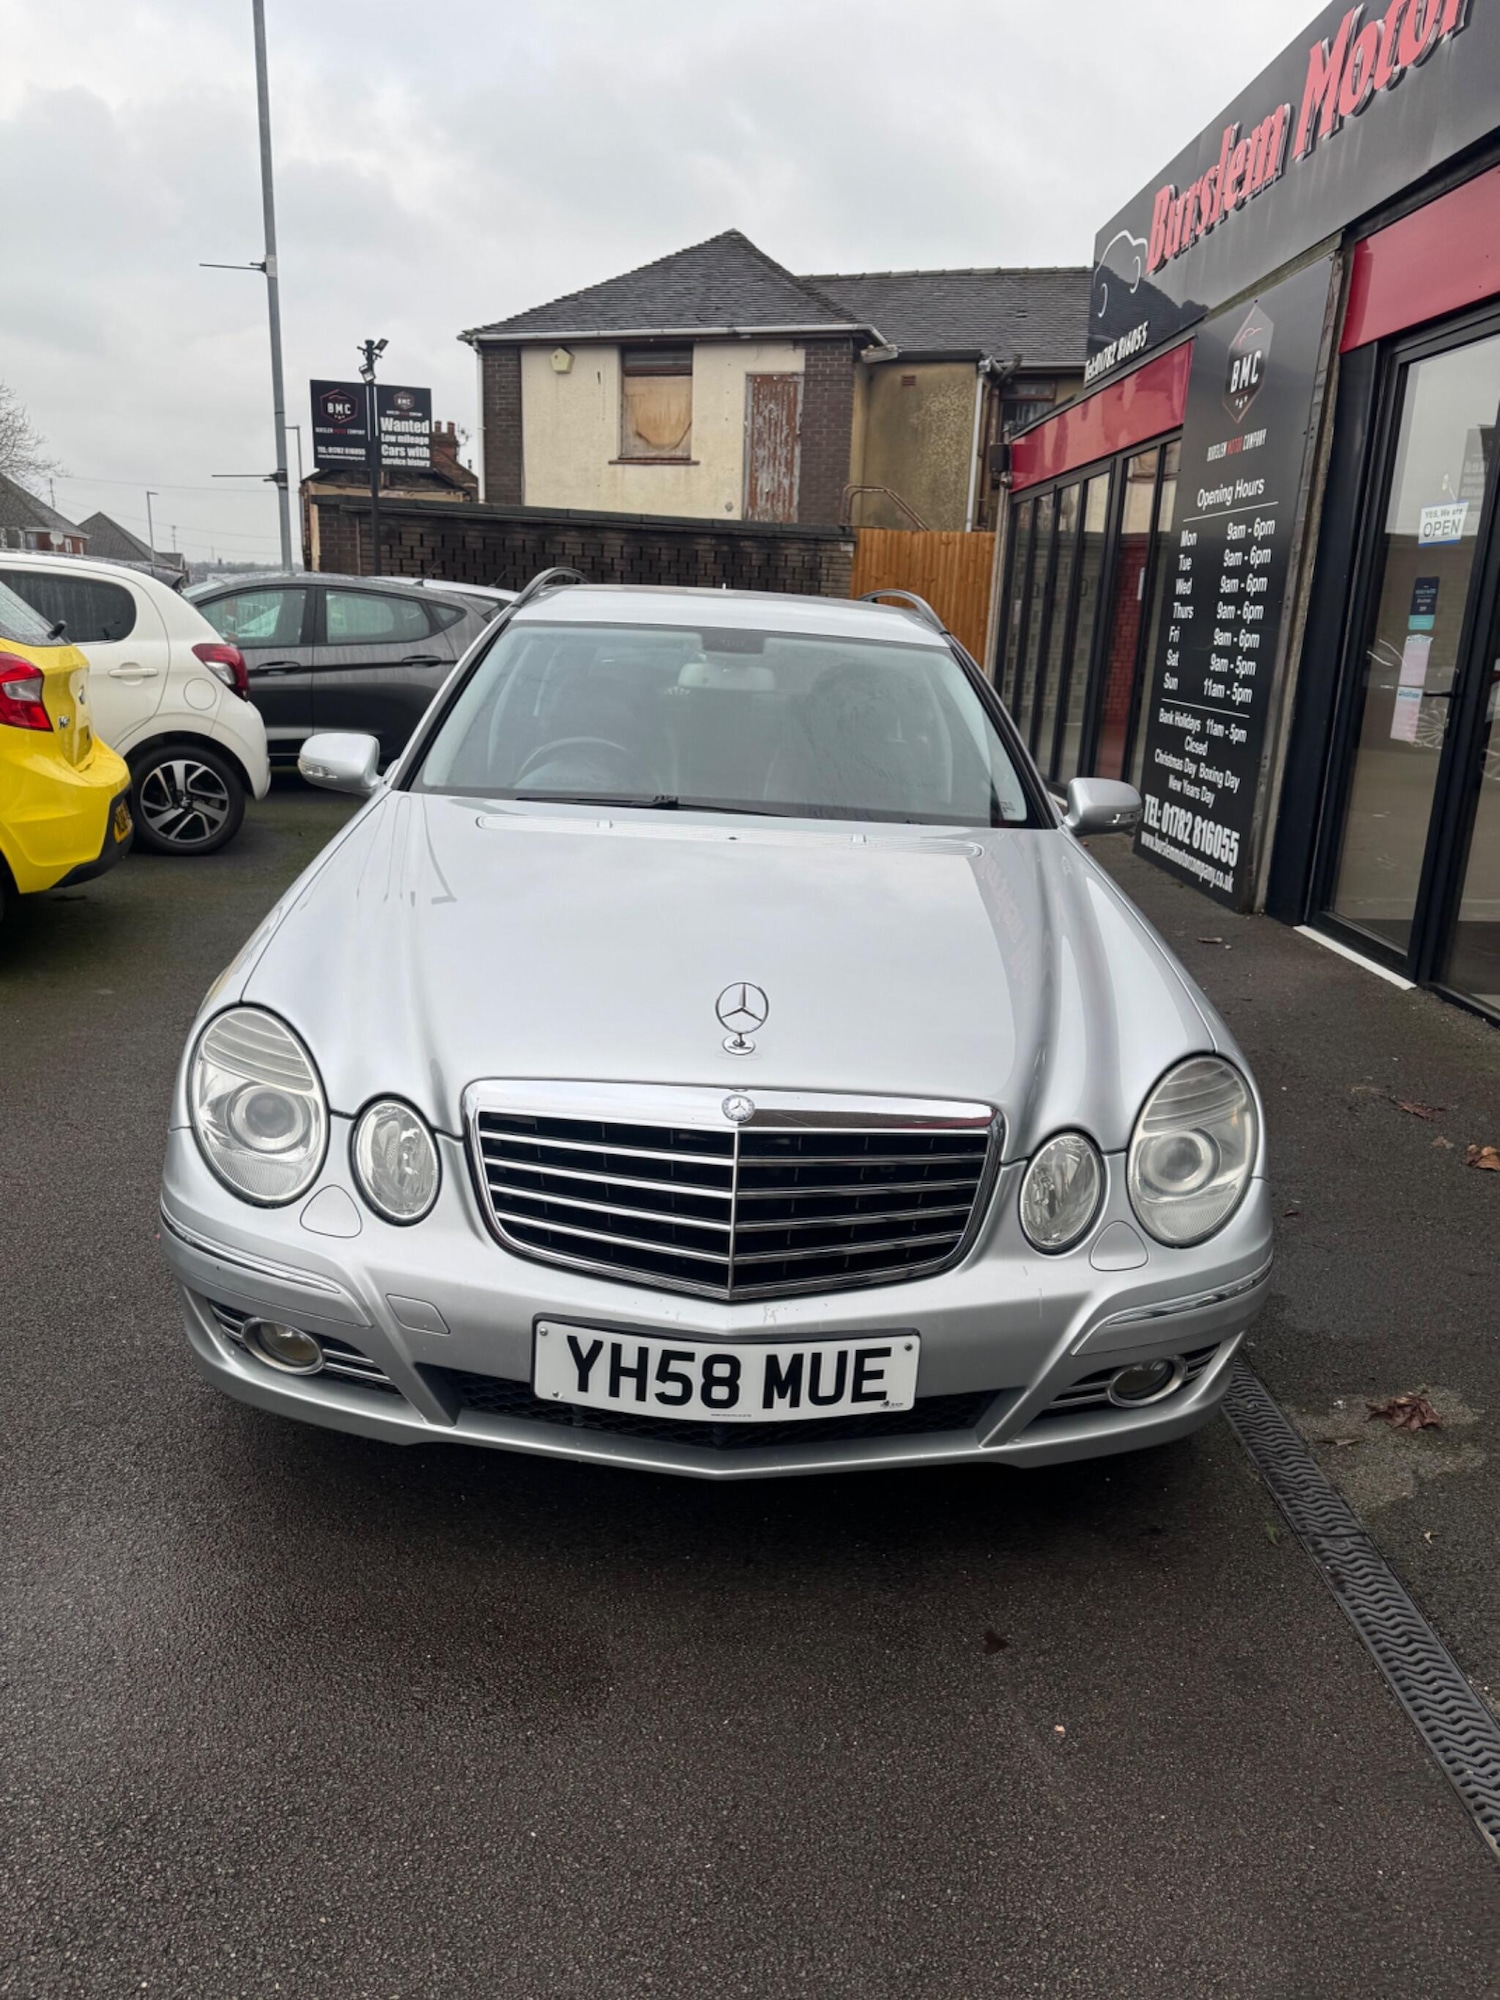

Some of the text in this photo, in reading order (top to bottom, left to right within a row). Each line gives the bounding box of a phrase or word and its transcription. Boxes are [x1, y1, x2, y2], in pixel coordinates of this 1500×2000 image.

[1146, 104, 1290, 276] Burslem
[1230, 350, 1262, 393] BMC
[327, 402, 351, 415] BMC
[380, 417, 430, 434] Wanted
[381, 433, 430, 445] Low mileage
[381, 443, 406, 456] Cars
[407, 446, 430, 458] with
[381, 457, 431, 467] service history
[1197, 478, 1265, 511] Opening Hours
[1441, 508, 1451, 517] We
[1452, 507, 1463, 516] are
[1180, 529, 1198, 547] Mon
[1227, 522, 1246, 540] 9am
[1253, 517, 1276, 544] 6pm
[1423, 518, 1461, 538] OPEN
[1178, 554, 1192, 571] Tue
[1223, 549, 1243, 567] 9am
[1250, 546, 1271, 570] 6pm
[1175, 578, 1193, 595] Wed
[1219, 575, 1239, 593] 9am
[1246, 573, 1268, 596] 6pm
[1172, 602, 1194, 619] Thurs
[1216, 601, 1235, 619] 9am
[1242, 601, 1264, 624] 6pm
[1168, 626, 1180, 643] Fri
[1213, 628, 1232, 646] 9am
[1238, 628, 1260, 652] 6pm
[1166, 649, 1180, 666] Sat
[1209, 653, 1228, 672] 9am
[1235, 655, 1256, 678] 5pm
[1163, 672, 1179, 690] Sun
[1203, 678, 1225, 698] 11am
[1231, 682, 1253, 706] 5pm
[1159, 708, 1175, 725] Bank
[1175, 710, 1201, 734] Holidays
[1206, 718, 1225, 737] 11am
[1229, 723, 1247, 744] 5pm
[1184, 735, 1208, 756] Closed
[1155, 748, 1241, 794] Christmas Day Boxing Day
[1168, 774, 1215, 808] New Years Day
[1161, 801, 1193, 845] 01782
[1192, 815, 1240, 867] 816055
[566, 1334, 892, 1409] YH58 MUE
